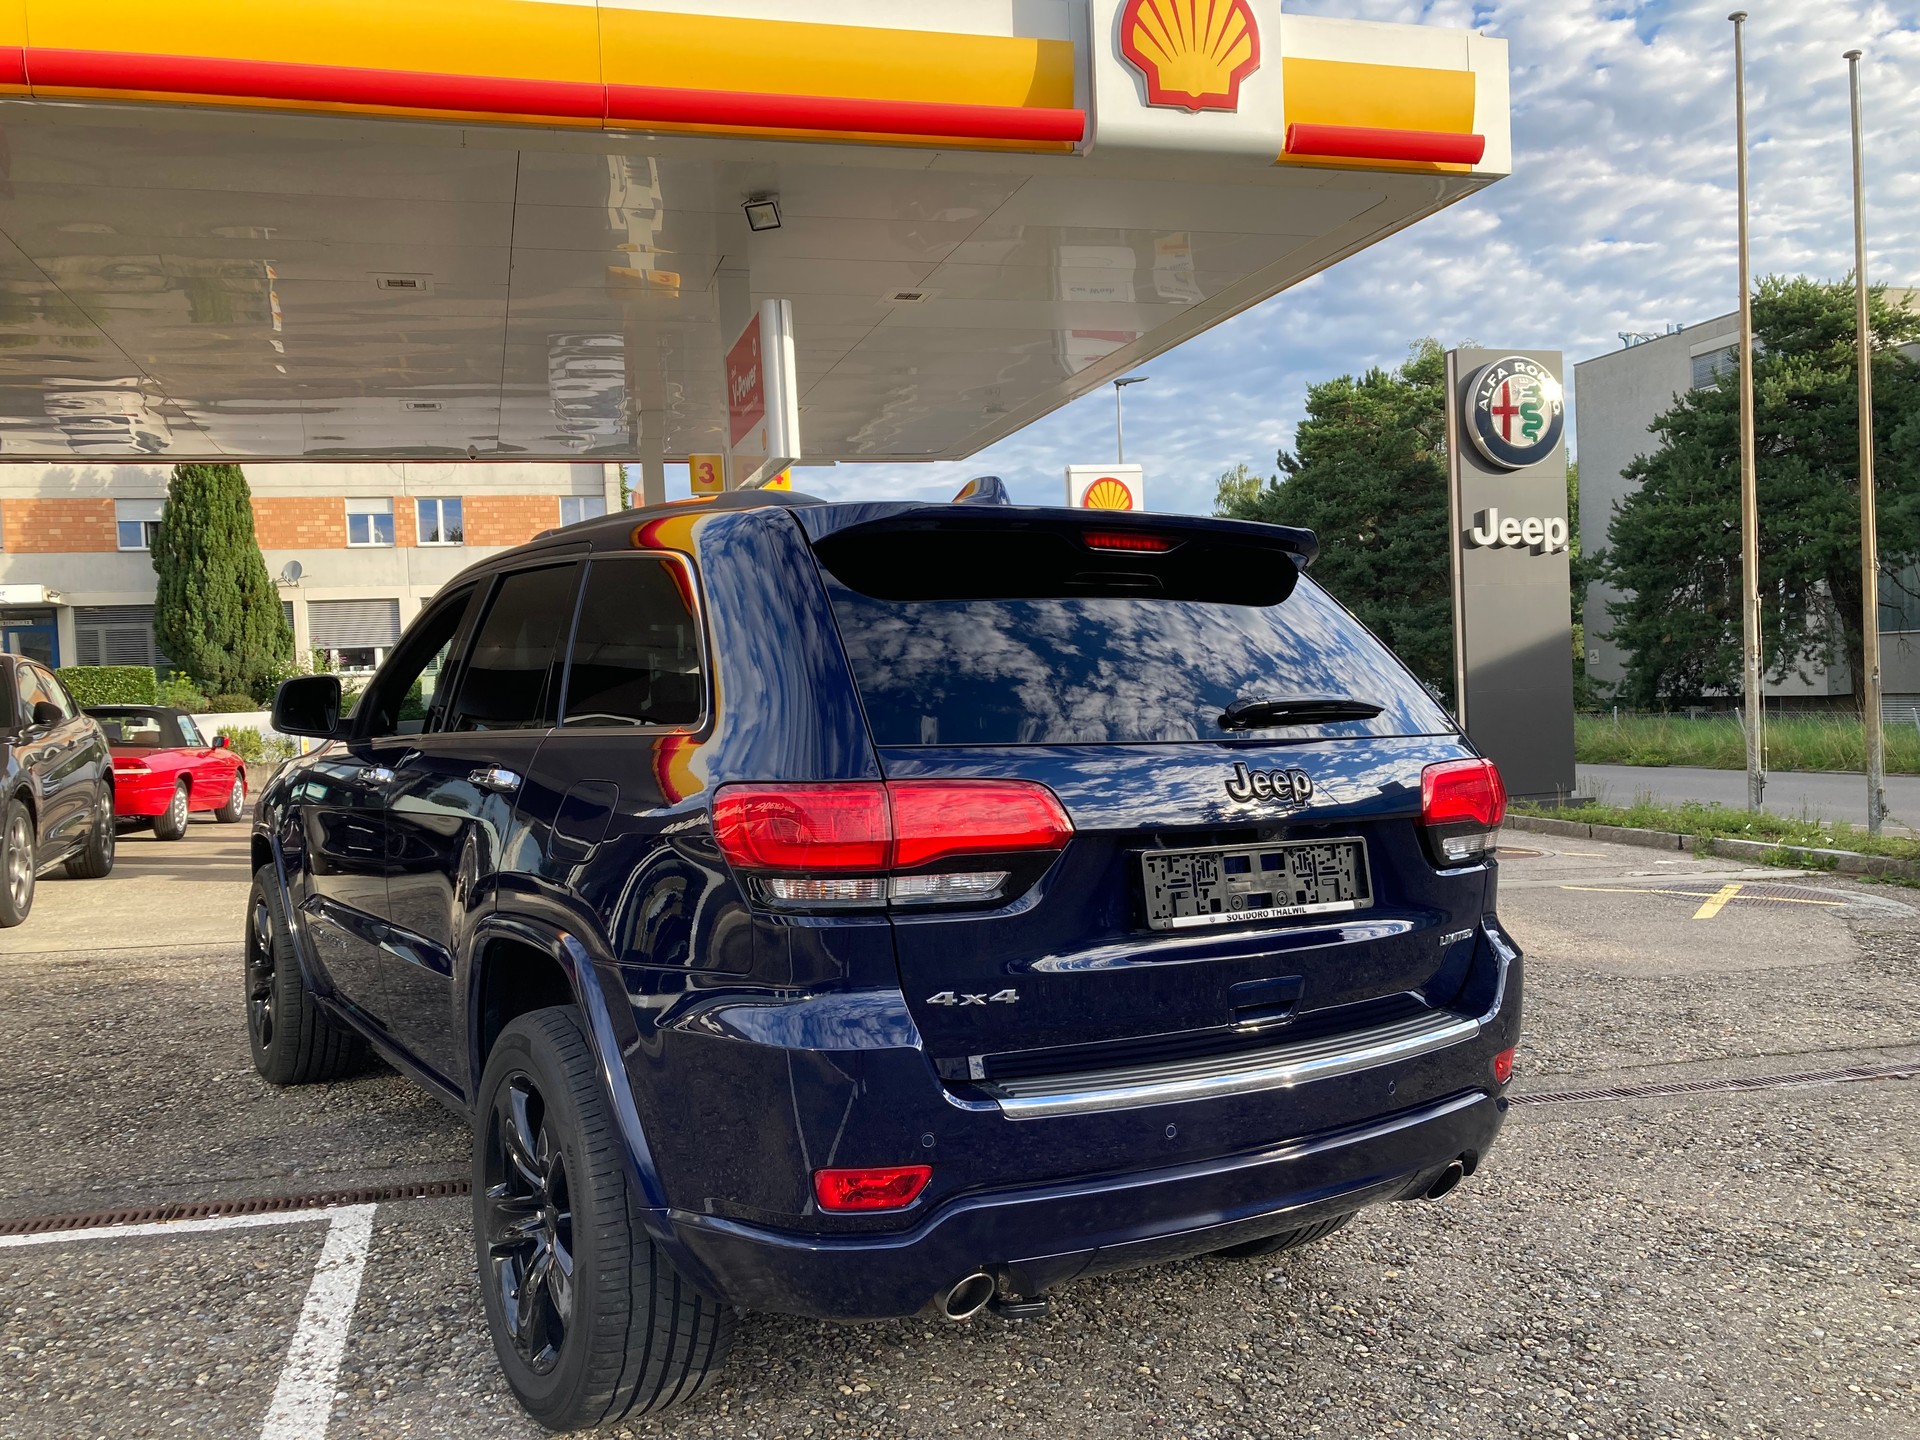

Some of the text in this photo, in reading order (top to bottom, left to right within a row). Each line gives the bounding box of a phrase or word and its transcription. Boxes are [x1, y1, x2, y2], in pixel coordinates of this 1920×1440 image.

[731, 364, 757, 407] V-Power
[1479, 362, 1560, 415] ALFA ROO
[699, 463, 715, 484] 3
[1471, 508, 1567, 552] Jeep
[1224, 761, 1314, 808] Jeep
[1226, 906, 1307, 922] SOLIDORO THALWIL
[926, 989, 1020, 1006] 4x4
